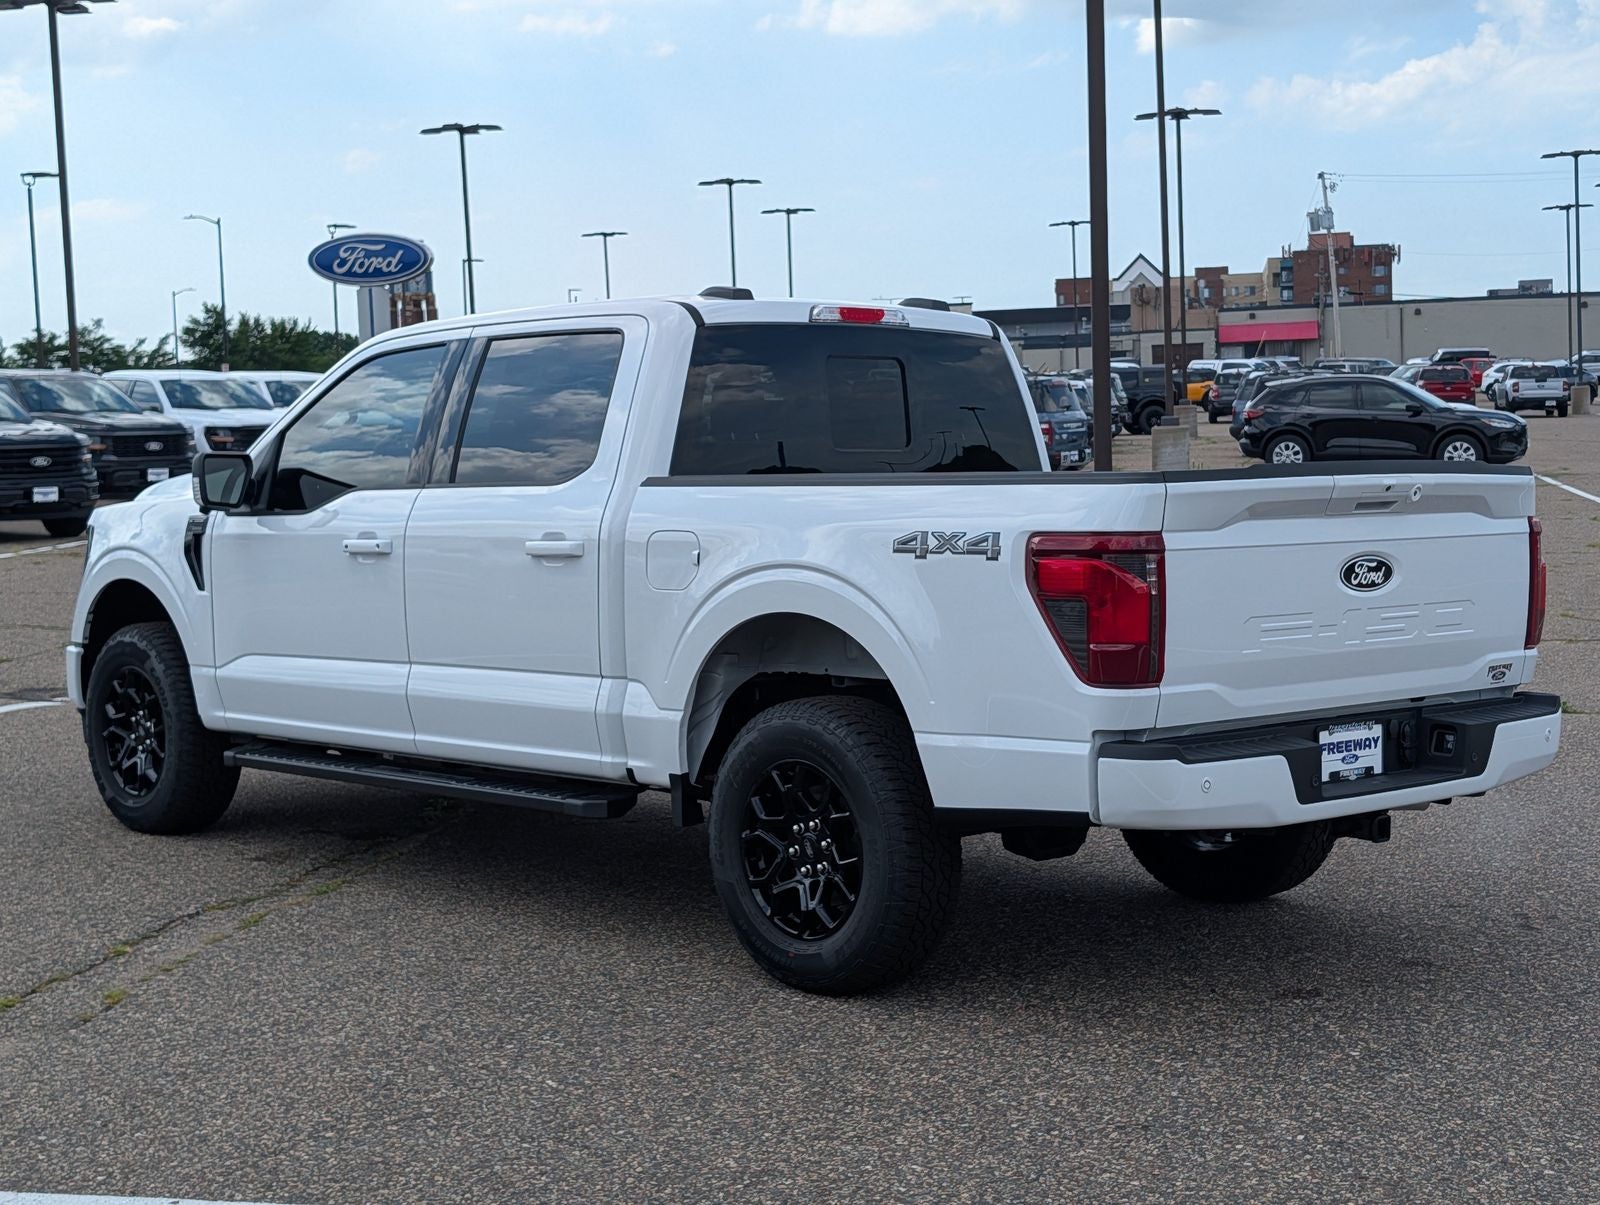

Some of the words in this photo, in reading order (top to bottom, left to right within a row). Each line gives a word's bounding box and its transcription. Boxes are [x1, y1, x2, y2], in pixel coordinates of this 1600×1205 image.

[332, 242, 404, 274] Ford
[1351, 561, 1386, 585] Ford
[1320, 736, 1381, 755] FREEWAY
